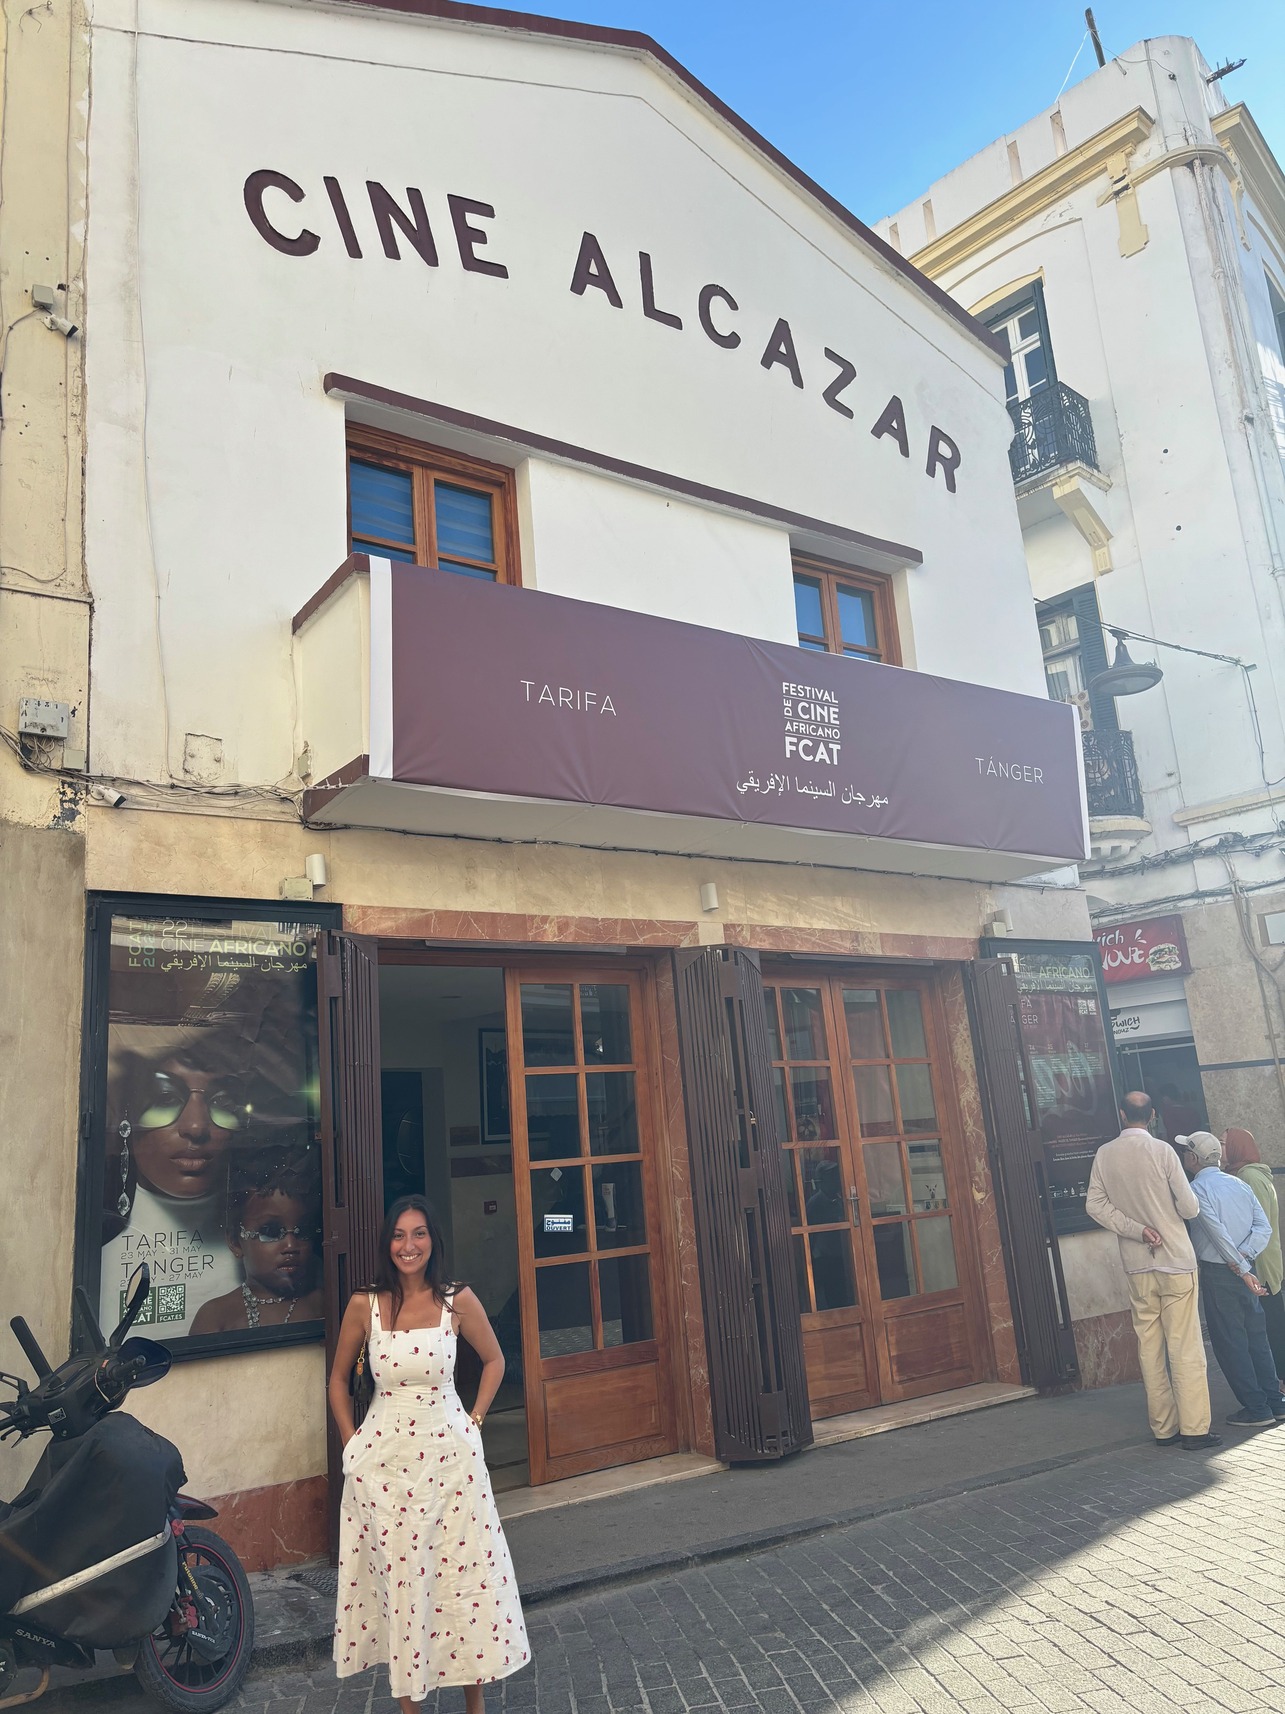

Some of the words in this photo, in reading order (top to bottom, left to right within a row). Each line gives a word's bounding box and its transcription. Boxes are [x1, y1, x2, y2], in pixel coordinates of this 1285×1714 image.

[243, 168, 509, 279] CINE
[569, 230, 962, 494] ALCAZAR
[520, 679, 617, 717] TARIFA
[782, 682, 839, 704] FESTIVAL
[783, 699, 792, 717] DE
[797, 702, 840, 725] CINE
[785, 721, 841, 740] AFRICANO
[785, 737, 841, 765] FCAT
[974, 756, 1044, 784] TÁNGER
[736, 770, 790, 797] الإفريقي
[795, 776, 837, 800] السينما
[840, 784, 889, 808] مهرجان
[162, 919, 188, 938] 22
[129, 921, 141, 967] FCAT
[161, 938, 204, 953] CINE
[208, 940, 307, 956] AFRICANO
[217, 955, 257, 971] السينما
[260, 955, 308, 973] مهرجان
[1039, 965, 1091, 979] AFRICANO
[122, 1230, 203, 1251] TARIFA
[120, 1252, 134, 1260] 23
[137, 1249, 157, 1258] MAY
[183, 1245, 202, 1253] MAY
[121, 1254, 215, 1279] TNGER
[184, 1271, 204, 1280] MAY
[15, 1628, 56, 1649] SANYA
